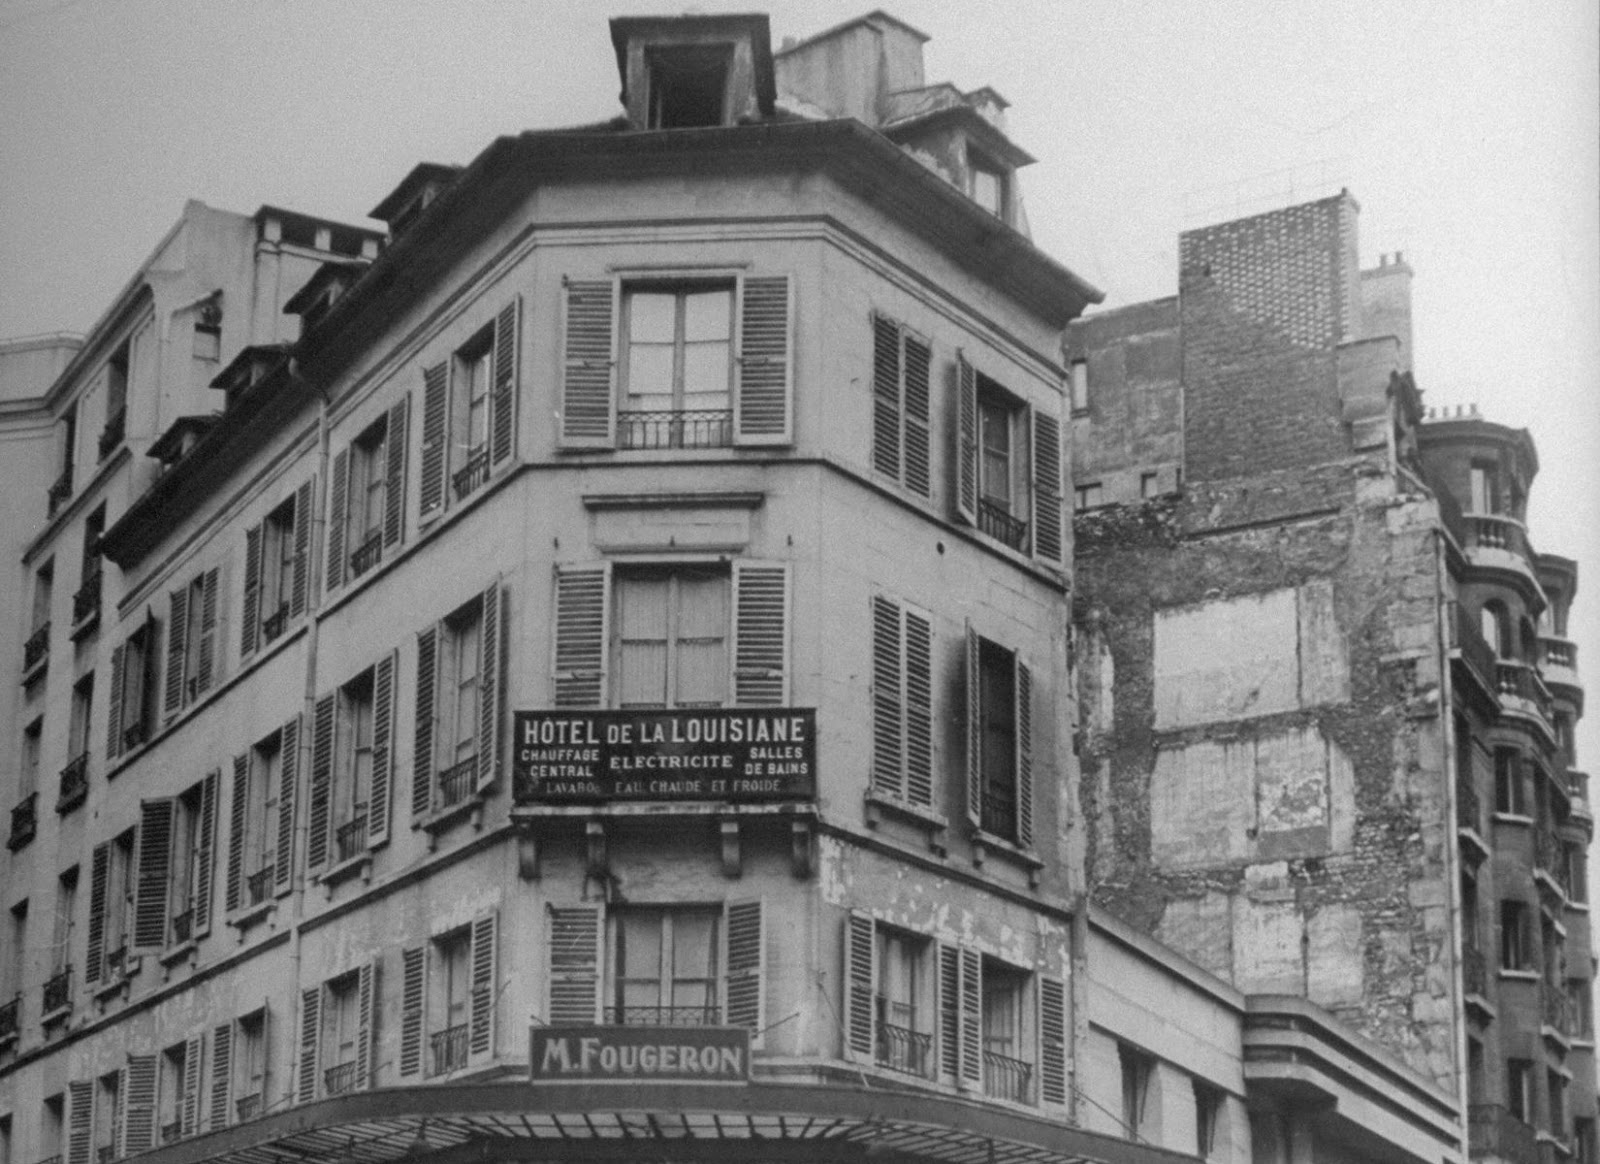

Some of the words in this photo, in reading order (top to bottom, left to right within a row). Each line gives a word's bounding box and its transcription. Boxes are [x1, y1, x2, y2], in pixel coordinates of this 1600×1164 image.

[607, 724, 633, 744] DE
[640, 722, 666, 743] LA
[671, 717, 806, 743] LOUISIANE
[521, 749, 600, 761] CHAUFFAGE
[750, 746, 803, 759] SALLES
[530, 764, 594, 777] CENTRAL
[744, 762, 763, 775] DE
[767, 762, 808, 775] BAINS
[648, 780, 701, 793] CHAUDE
[711, 780, 727, 792] ET
[733, 779, 781, 792] FROIDE
